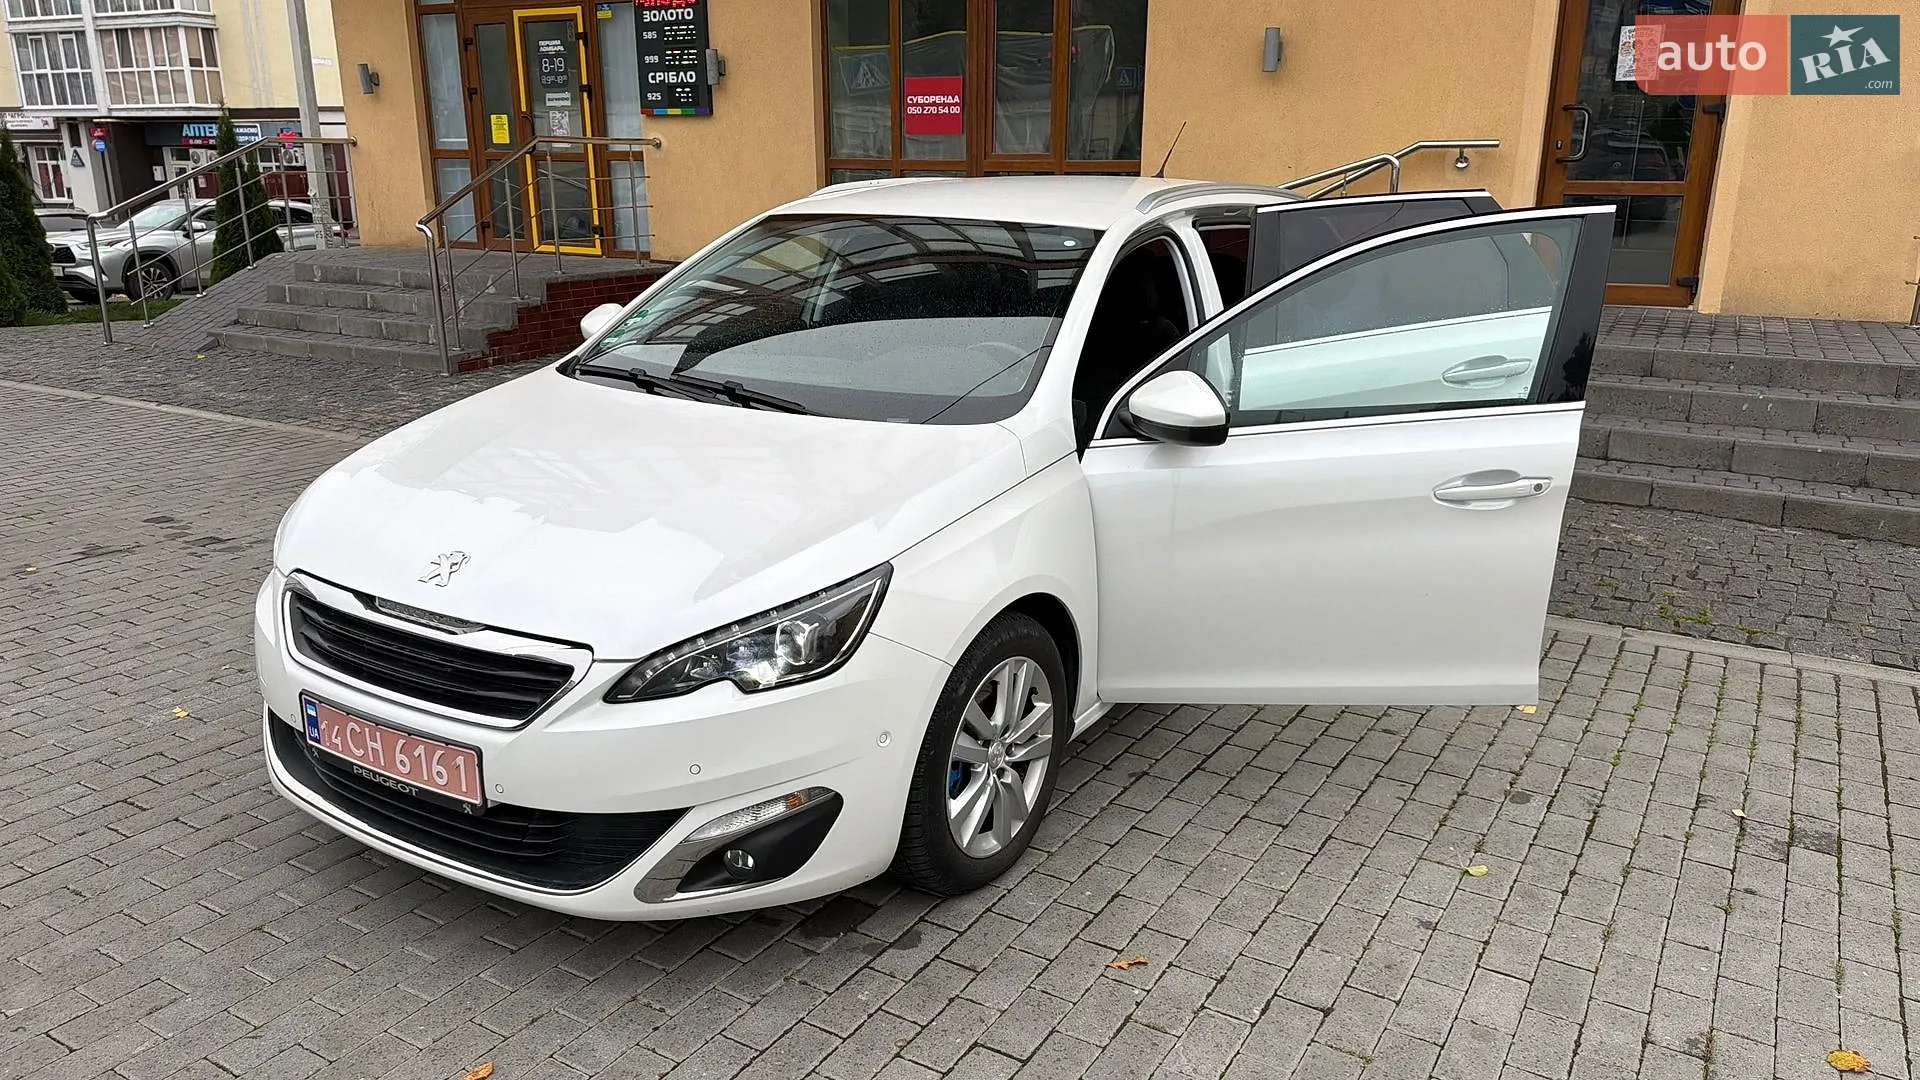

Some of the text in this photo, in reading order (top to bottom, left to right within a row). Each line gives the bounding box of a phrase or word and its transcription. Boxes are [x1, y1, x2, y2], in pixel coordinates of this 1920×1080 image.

[643, 8, 694, 22] ЗОЛОТО
[642, 31, 658, 39] 585
[542, 57, 565, 72] 8-19
[644, 55, 659, 64] 999
[648, 71, 696, 84] СРІБЛО
[647, 93, 662, 101] 925
[907, 95, 960, 104] СУБОРЕНДА
[907, 105, 961, 114] 050 270 54 00
[309, 726, 320, 740] UA
[395, 739, 468, 793] 6161
[352, 765, 420, 797] PEUGEOT
